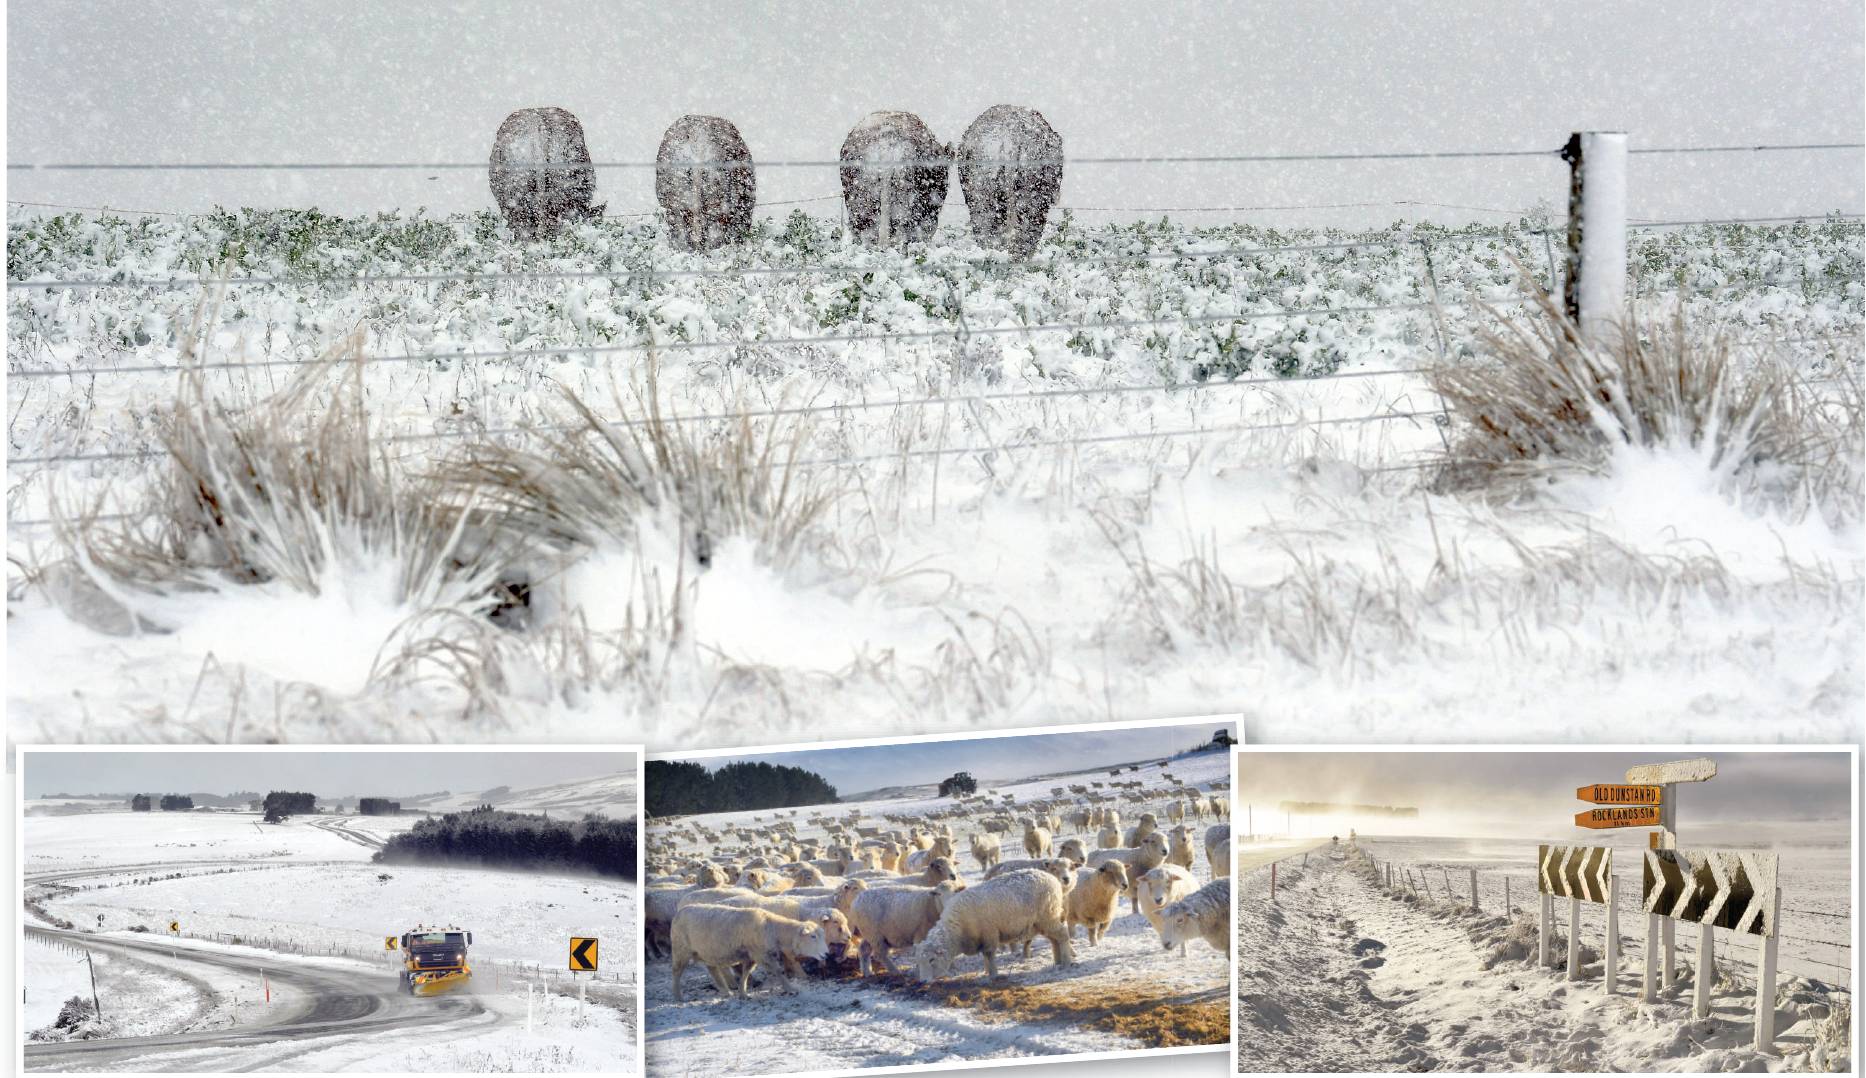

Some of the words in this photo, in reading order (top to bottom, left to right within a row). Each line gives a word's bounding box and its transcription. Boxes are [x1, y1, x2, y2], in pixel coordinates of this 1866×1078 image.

[1594, 787, 1608, 801] OLD
[1610, 787, 1645, 802] DUNSTAN
[1646, 789, 1656, 802] RD
[1592, 808, 1639, 822] ROCKLANDS
[1640, 807, 1655, 819] STN
